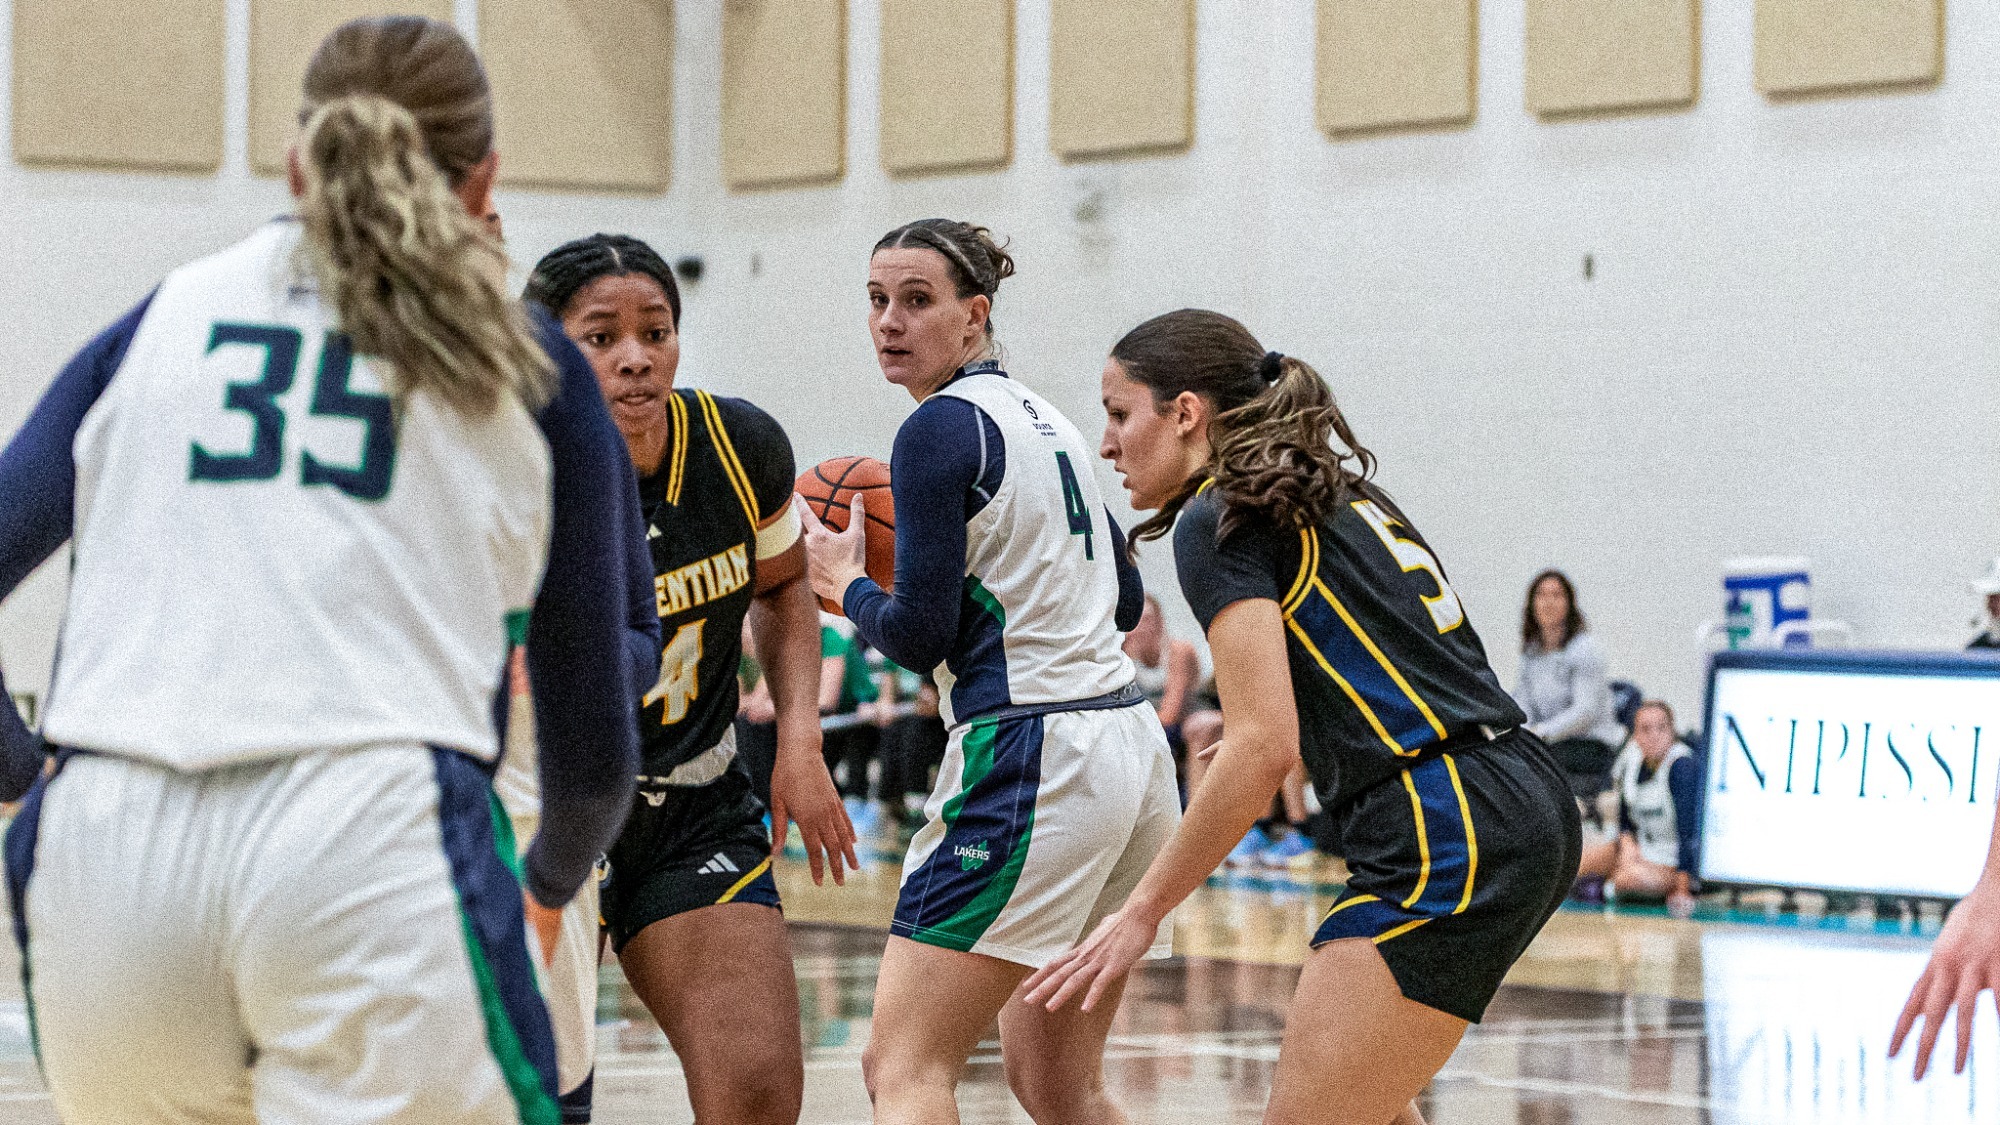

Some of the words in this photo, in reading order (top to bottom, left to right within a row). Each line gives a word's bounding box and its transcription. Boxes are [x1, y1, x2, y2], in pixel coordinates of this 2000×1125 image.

[189, 323, 398, 502] 35
[1055, 451, 1094, 560] 4
[1350, 499, 1464, 634] 5
[643, 618, 707, 724] 4
[1718, 714, 1981, 803] NIPISSI
[954, 845, 990, 861] LAKERS
